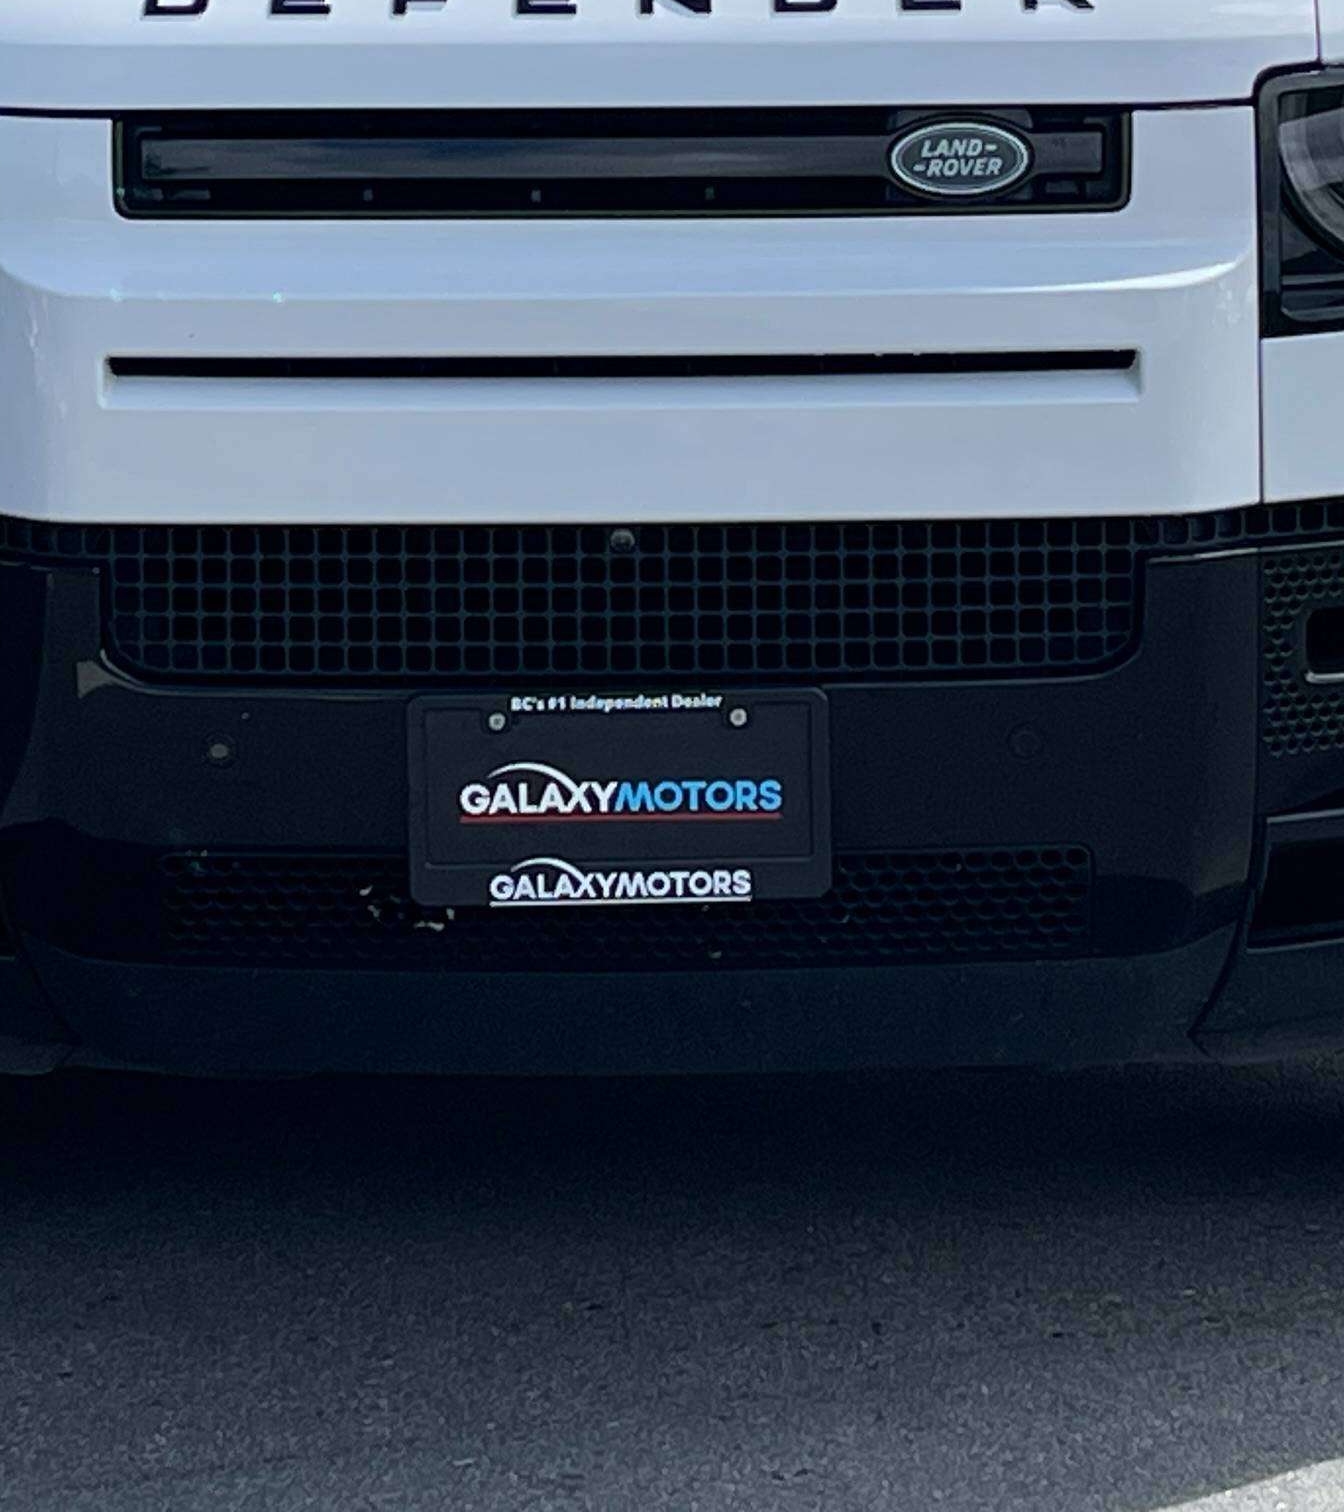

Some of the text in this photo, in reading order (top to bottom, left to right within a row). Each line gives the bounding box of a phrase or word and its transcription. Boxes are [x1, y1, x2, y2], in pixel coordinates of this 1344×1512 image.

[510, 696, 545, 711] BC's
[570, 694, 669, 713] Independent
[671, 692, 724, 709] Dealer
